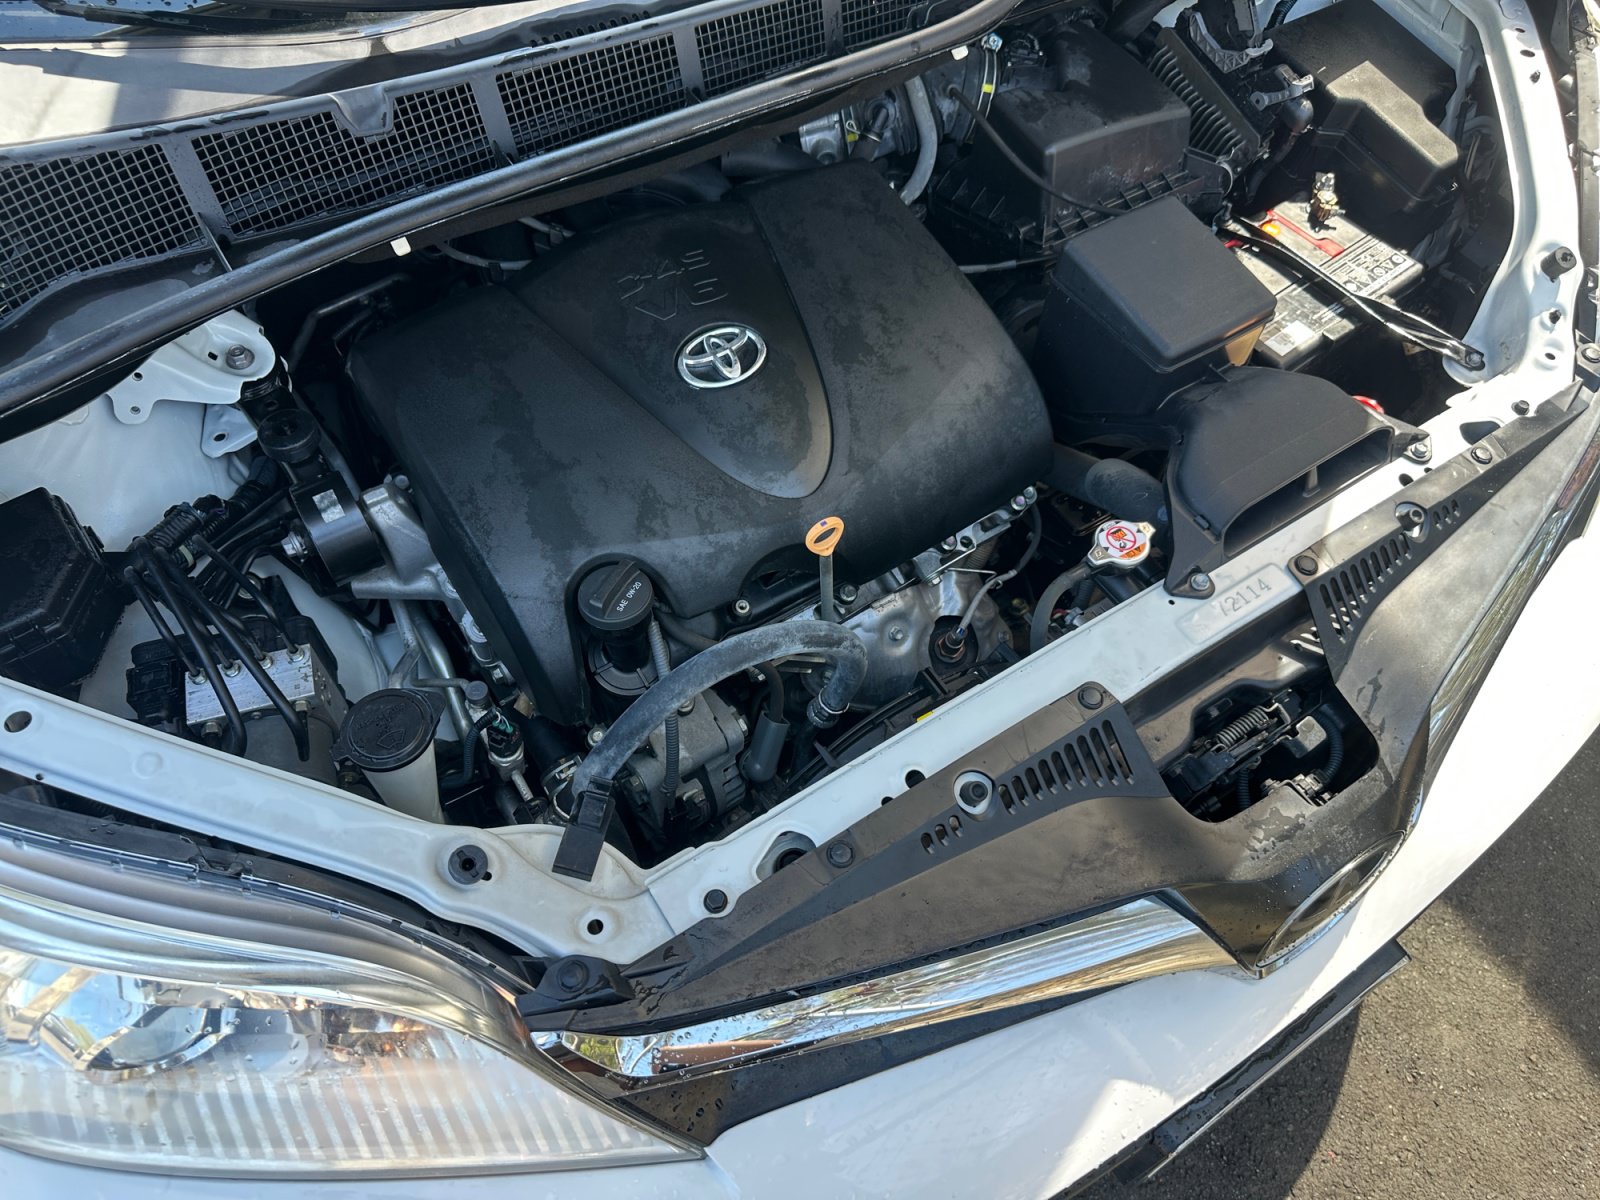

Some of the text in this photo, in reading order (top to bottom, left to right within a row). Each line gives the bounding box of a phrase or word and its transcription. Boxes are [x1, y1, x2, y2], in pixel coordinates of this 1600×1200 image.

[634, 278, 729, 321] V6
[616, 581, 642, 612] SAE 0W-20
